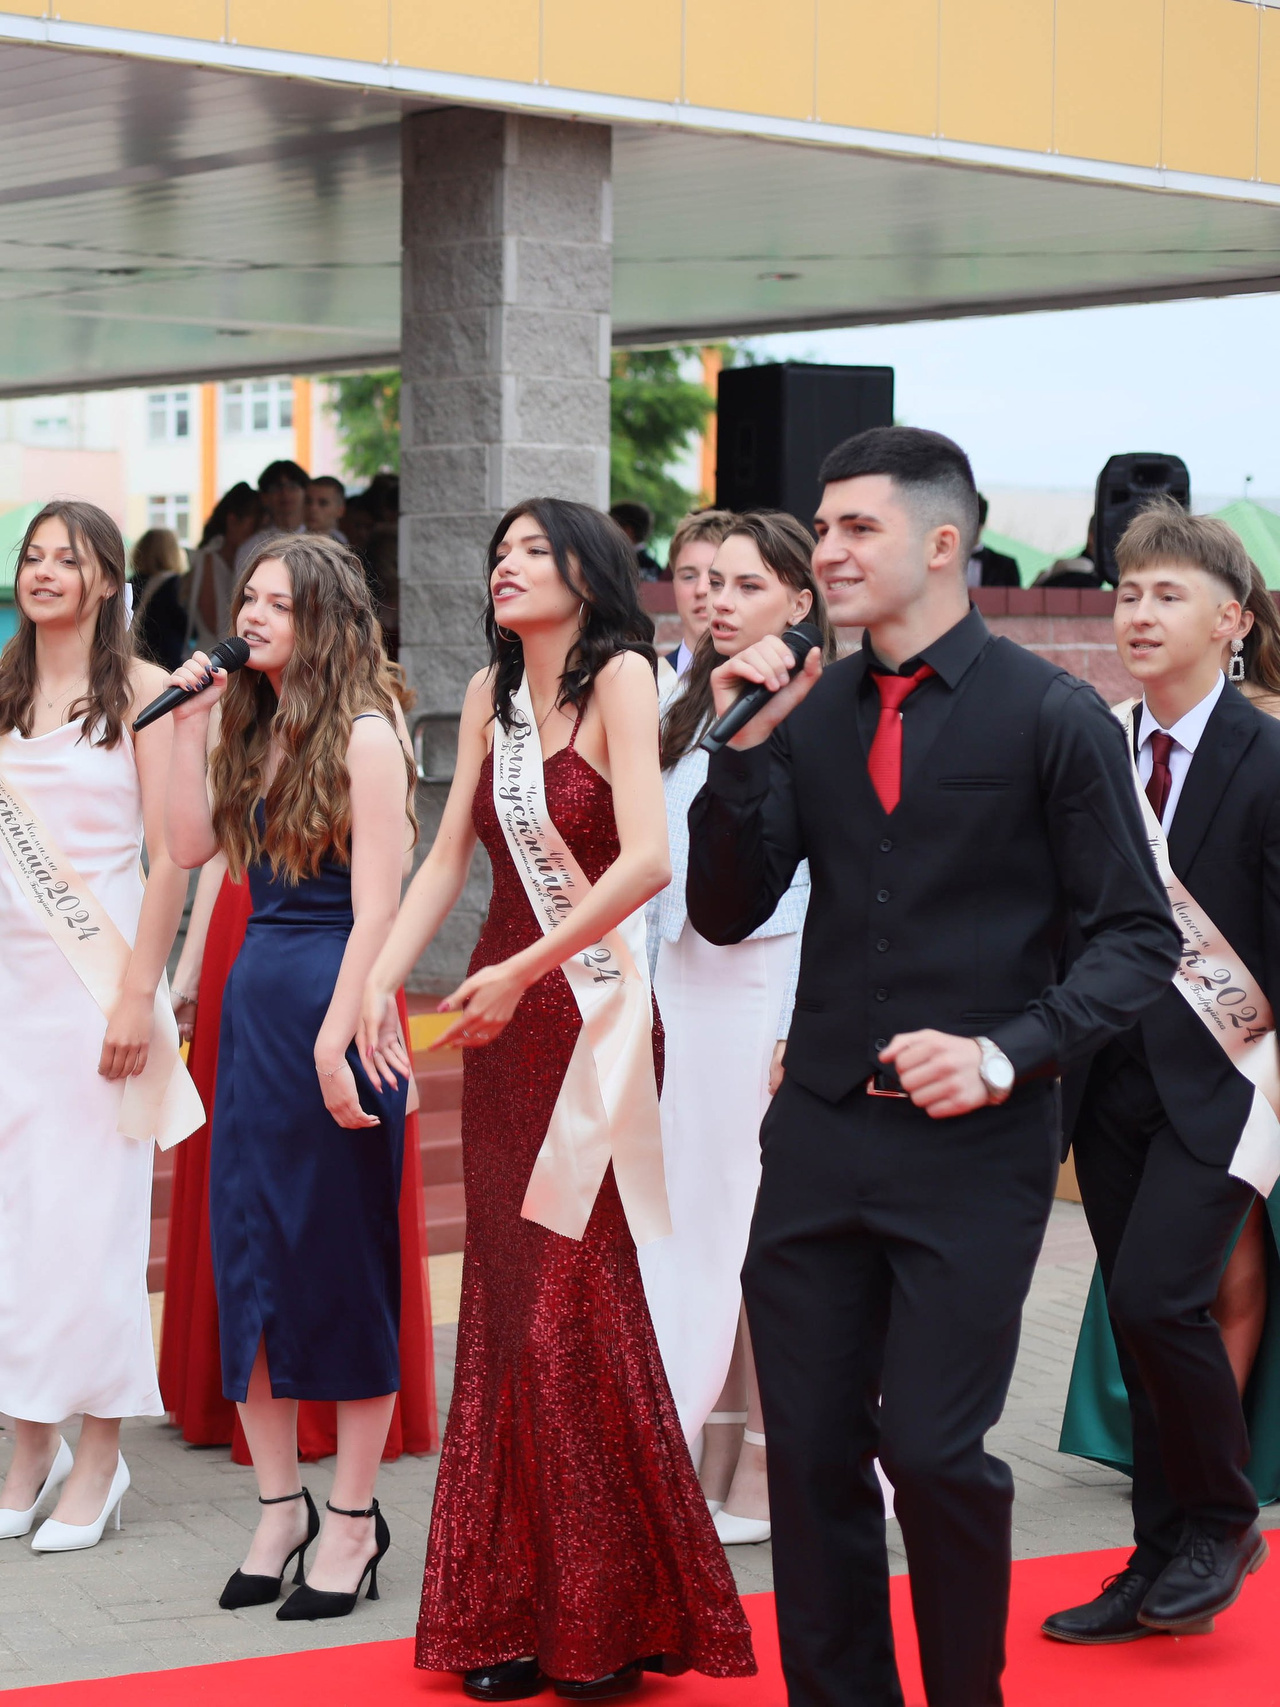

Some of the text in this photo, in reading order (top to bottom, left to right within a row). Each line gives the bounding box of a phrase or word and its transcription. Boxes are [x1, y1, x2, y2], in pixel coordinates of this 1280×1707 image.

[499, 708, 573, 913] Выпускница
[44, 880, 101, 941] 2024
[1171, 901, 1211, 949] Максим
[1190, 983, 1226, 1031] Бобруйска
[1198, 968, 1268, 1045] 2024
